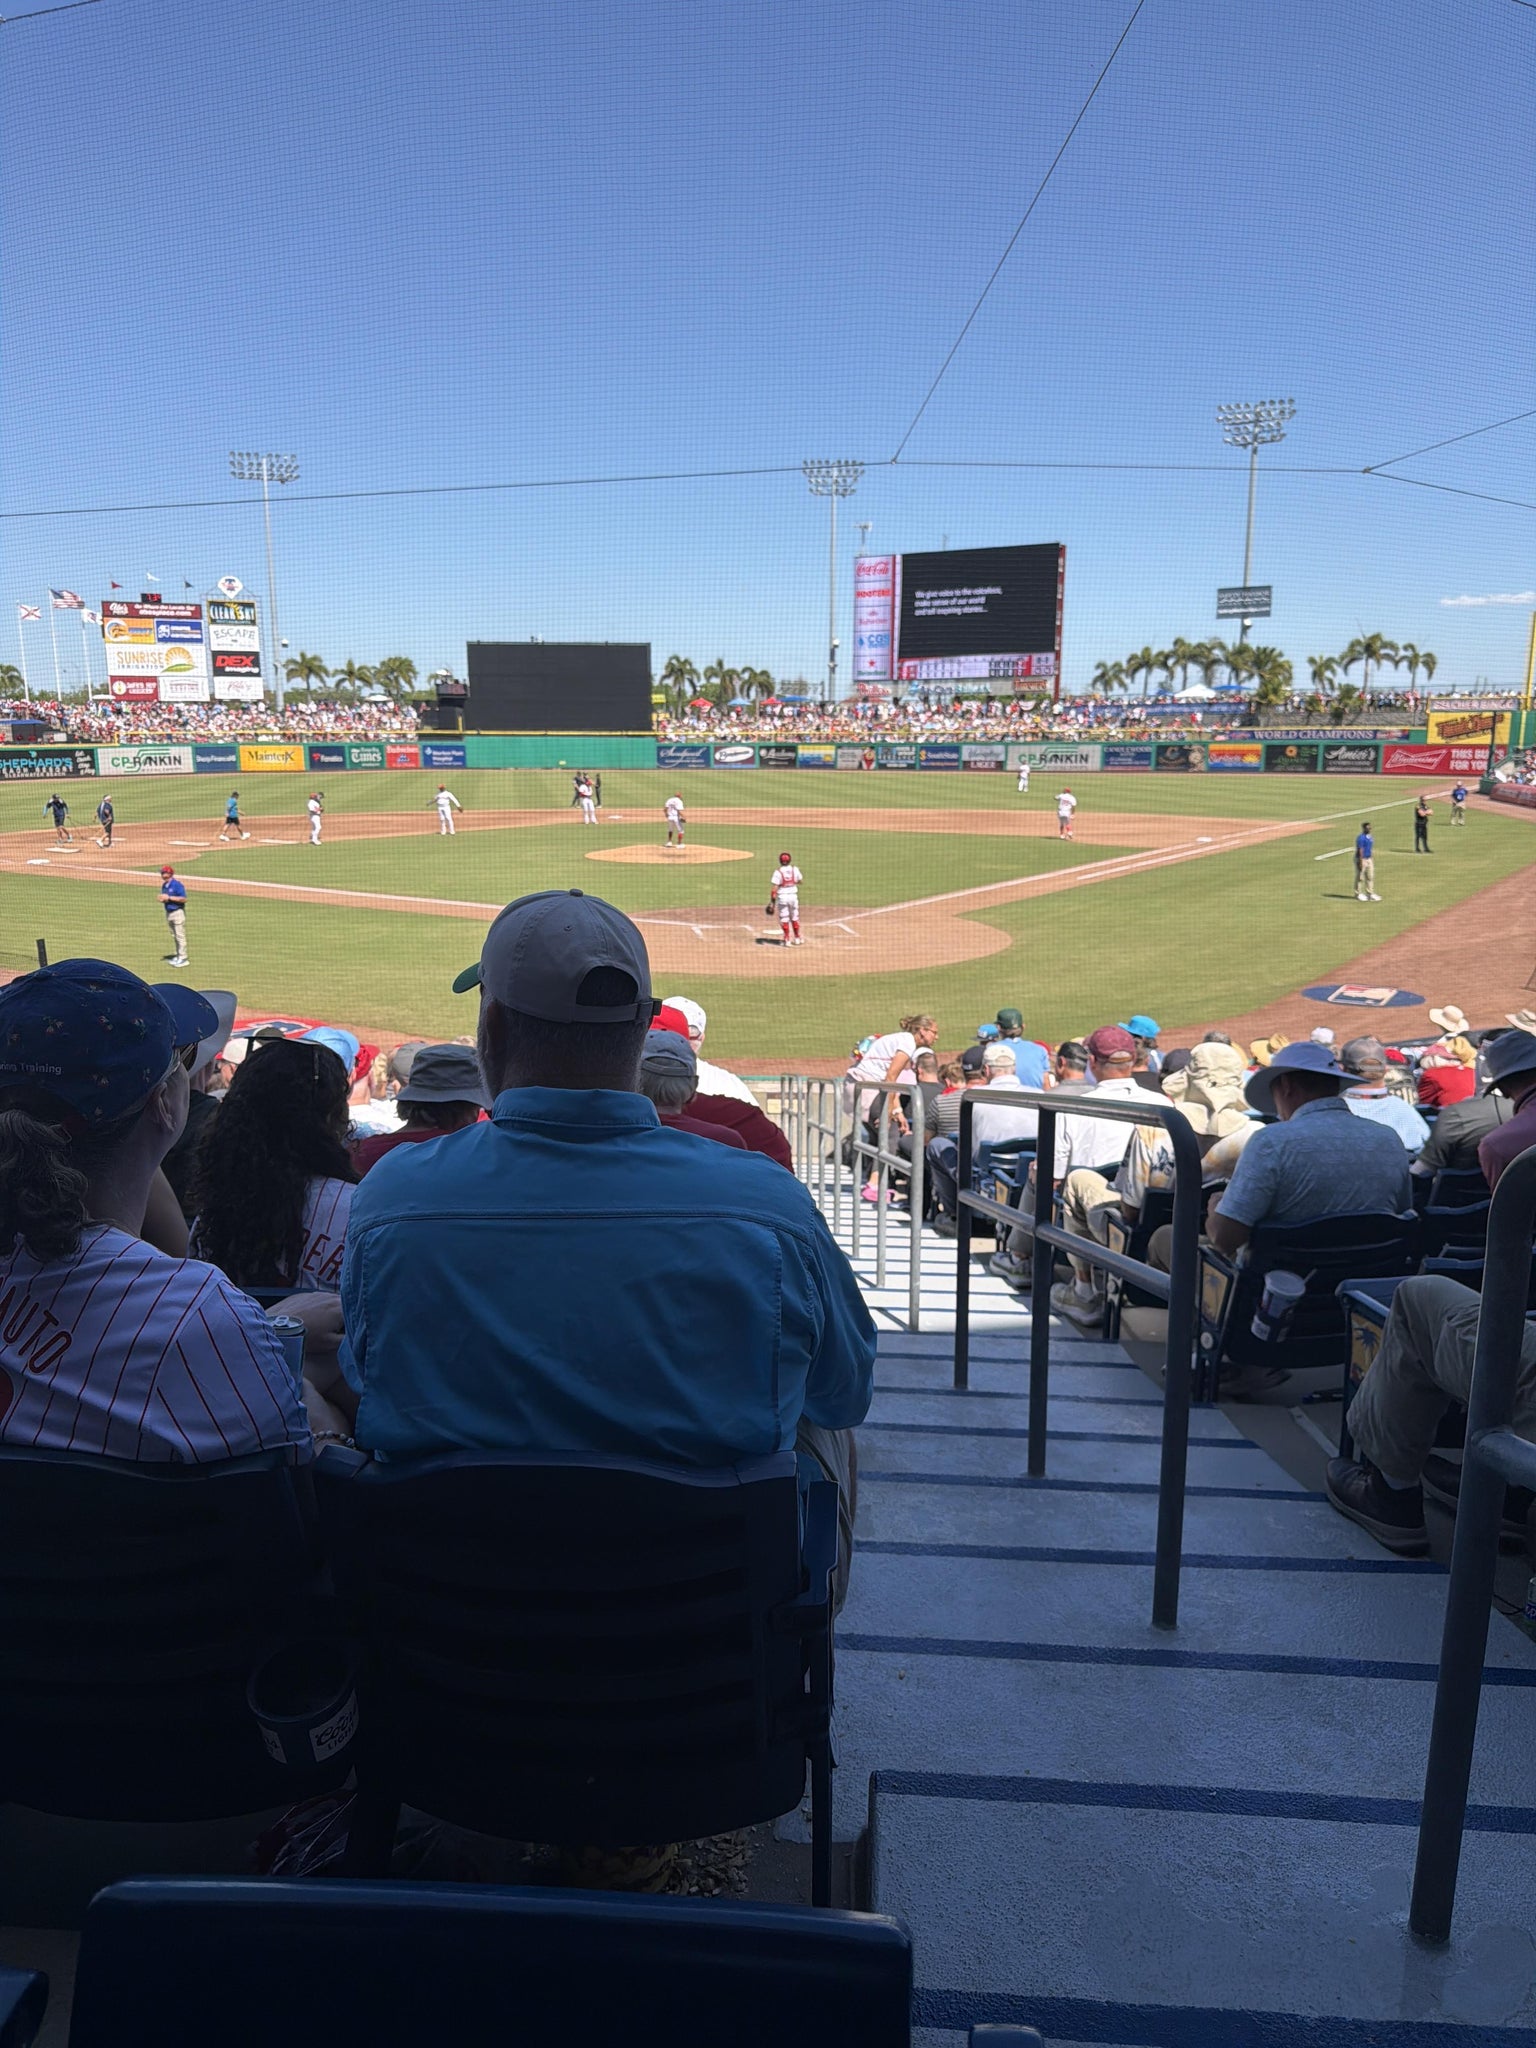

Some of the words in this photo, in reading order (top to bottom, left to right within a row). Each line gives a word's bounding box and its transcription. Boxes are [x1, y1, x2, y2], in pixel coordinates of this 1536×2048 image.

[857, 561, 890, 578] Coca-Cola
[213, 628, 256, 641] ESCAPE
[117, 650, 164, 665] SUNRISE
[216, 655, 255, 667] DEX
[1254, 730, 1299, 740] WORLD
[1299, 729, 1375, 740] CHAMPIONS
[351, 748, 382, 763] Times
[1451, 749, 1474, 760] THIS
[1449, 760, 1471, 771] FOR
[19, 1060, 63, 1077] Training
[303, 1229, 345, 1282] ER
